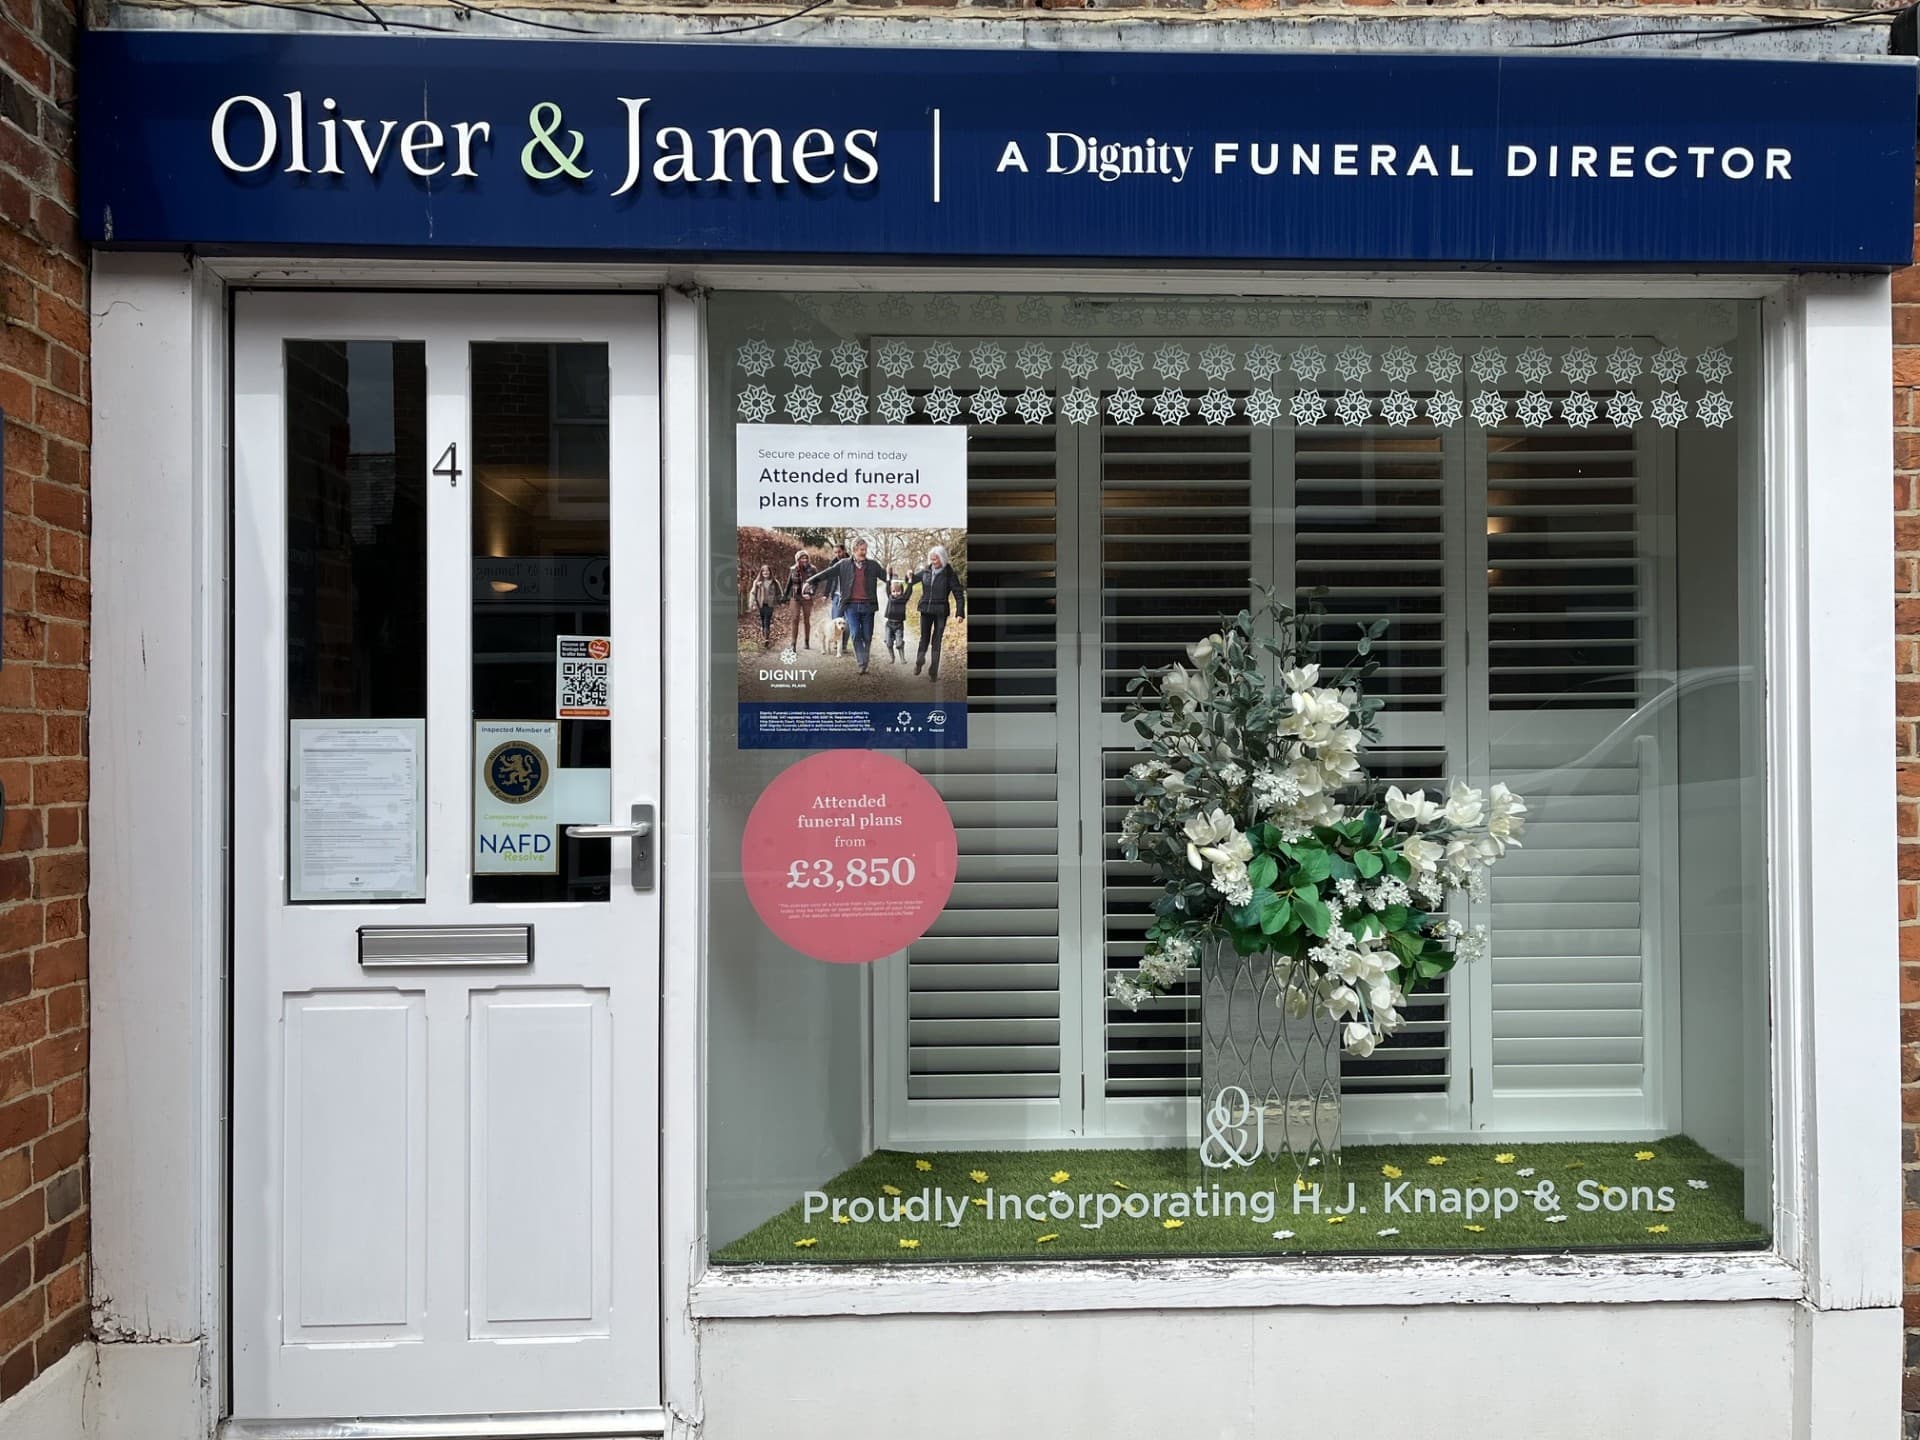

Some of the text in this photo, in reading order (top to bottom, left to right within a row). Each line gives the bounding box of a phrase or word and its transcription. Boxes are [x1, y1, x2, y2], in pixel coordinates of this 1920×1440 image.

[211, 91, 879, 197] Oliver & James
[997, 132, 1792, 183] A Dignity FUNERAL DIRECTOR
[433, 442, 462, 487] 4
[758, 449, 908, 462] Secure peace of mind today
[759, 468, 919, 484] Attended funeral
[759, 491, 932, 510] plans from £3,850
[759, 669, 818, 681] DIGNITY
[812, 794, 887, 809] Attended
[798, 812, 902, 830] funeral plans
[480, 834, 551, 854] NAFD
[834, 835, 866, 848] from
[504, 851, 545, 861] Resolve
[803, 1179, 1676, 1226] Proudly Incorporating H.J. Knapp & Sons
